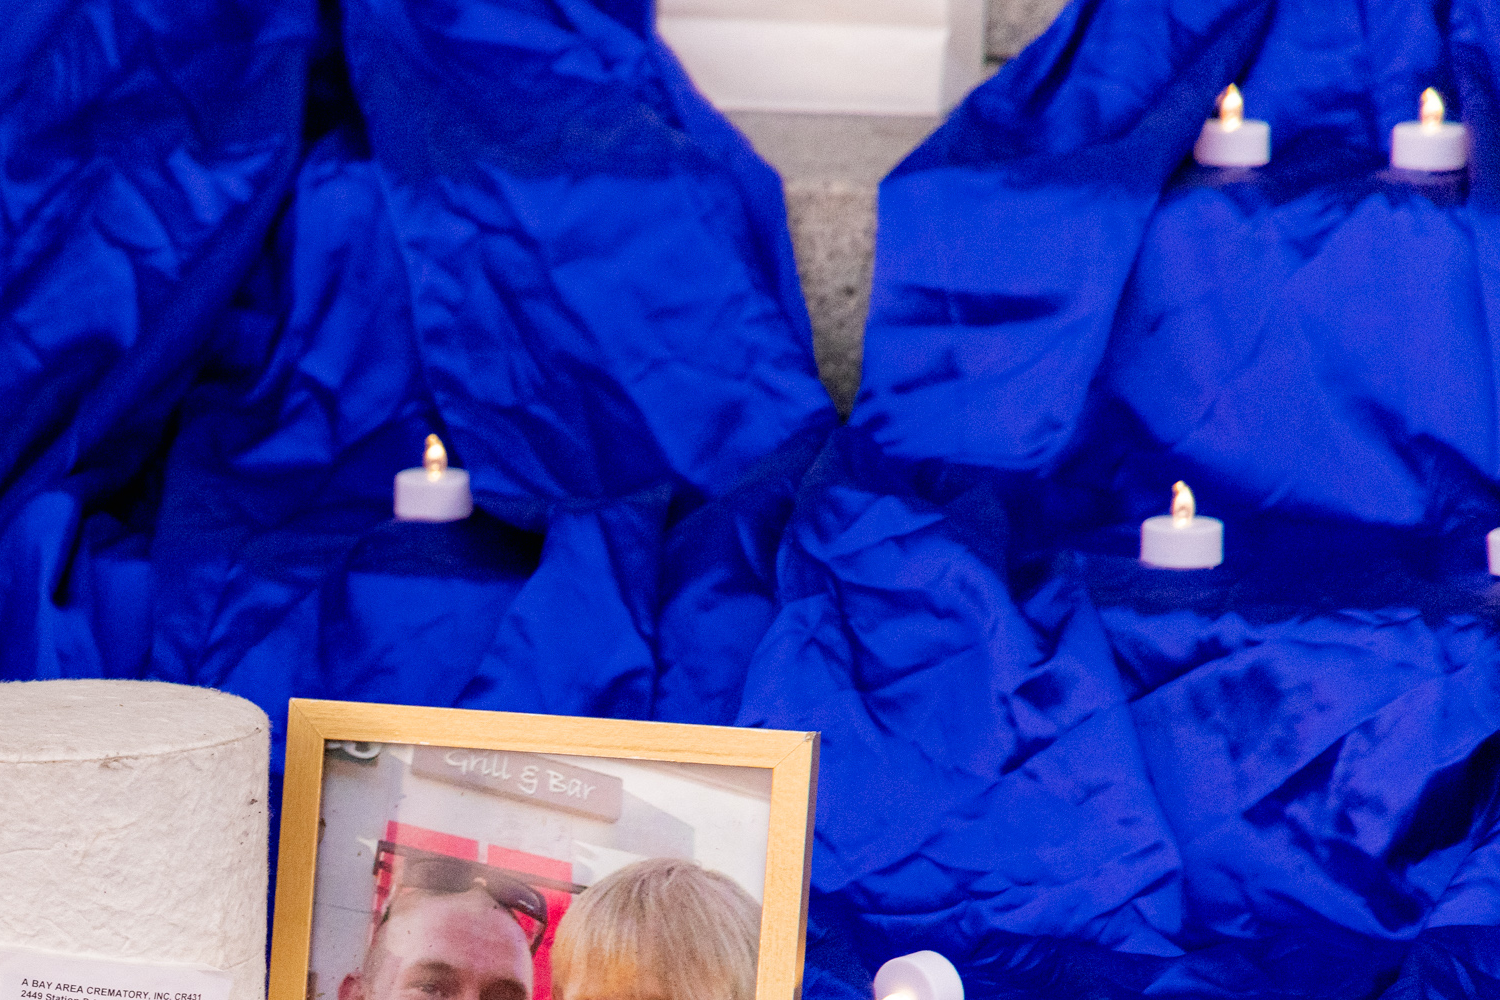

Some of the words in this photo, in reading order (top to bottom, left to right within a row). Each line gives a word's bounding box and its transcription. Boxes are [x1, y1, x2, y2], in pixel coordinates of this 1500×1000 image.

[444, 749, 512, 780] Grill
[545, 769, 597, 801] Bar
[21, 978, 29, 987] A
[32, 979, 53, 990] BAY
[55, 982, 84, 994] AREA
[86, 986, 151, 1000] CREMATORY,
[154, 992, 172, 1000] INC.
[21, 989, 43, 1000] 2449
